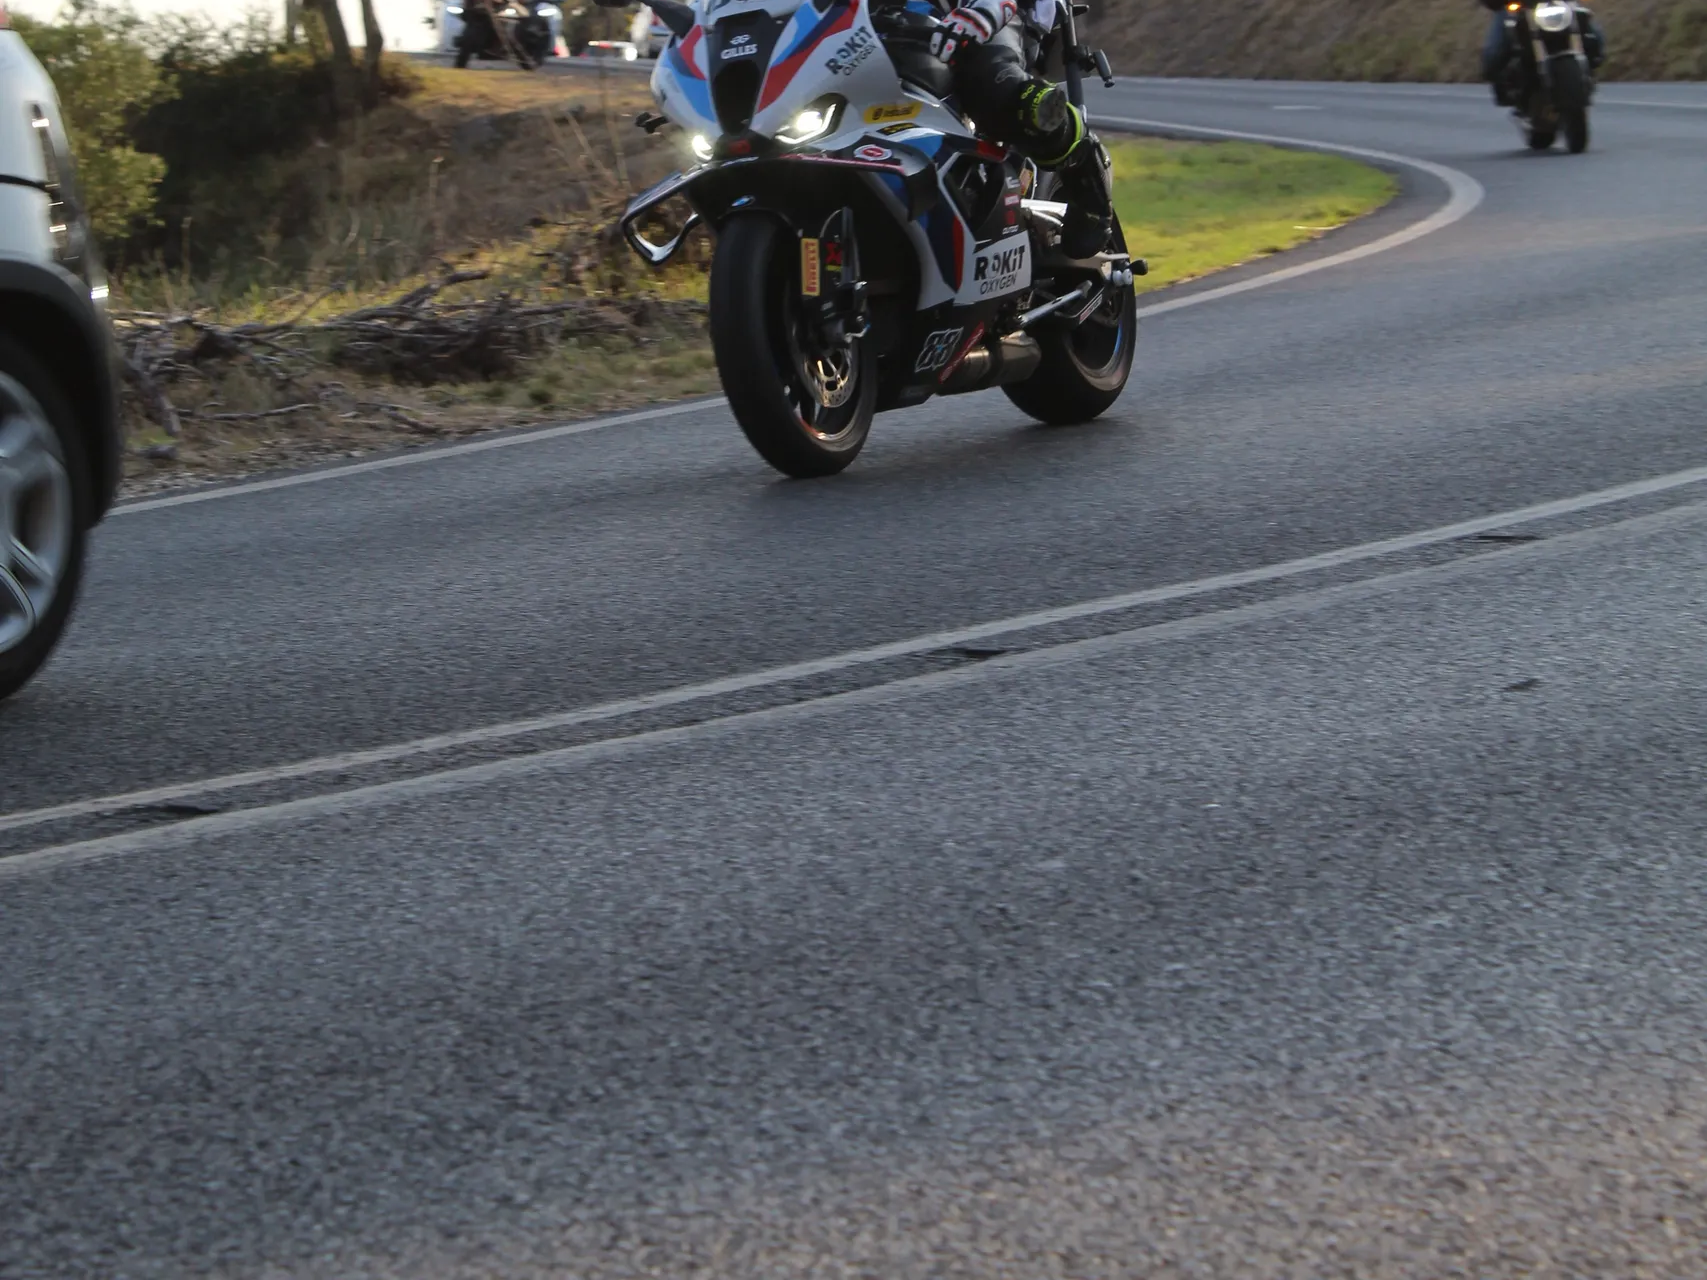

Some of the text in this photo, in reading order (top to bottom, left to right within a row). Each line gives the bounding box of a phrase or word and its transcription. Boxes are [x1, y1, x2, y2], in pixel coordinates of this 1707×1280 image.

[721, 44, 758, 59] GILLES
[842, 43, 878, 76] OXYGEN
[980, 272, 1018, 295] OXYGEN
[914, 326, 964, 373] 88
